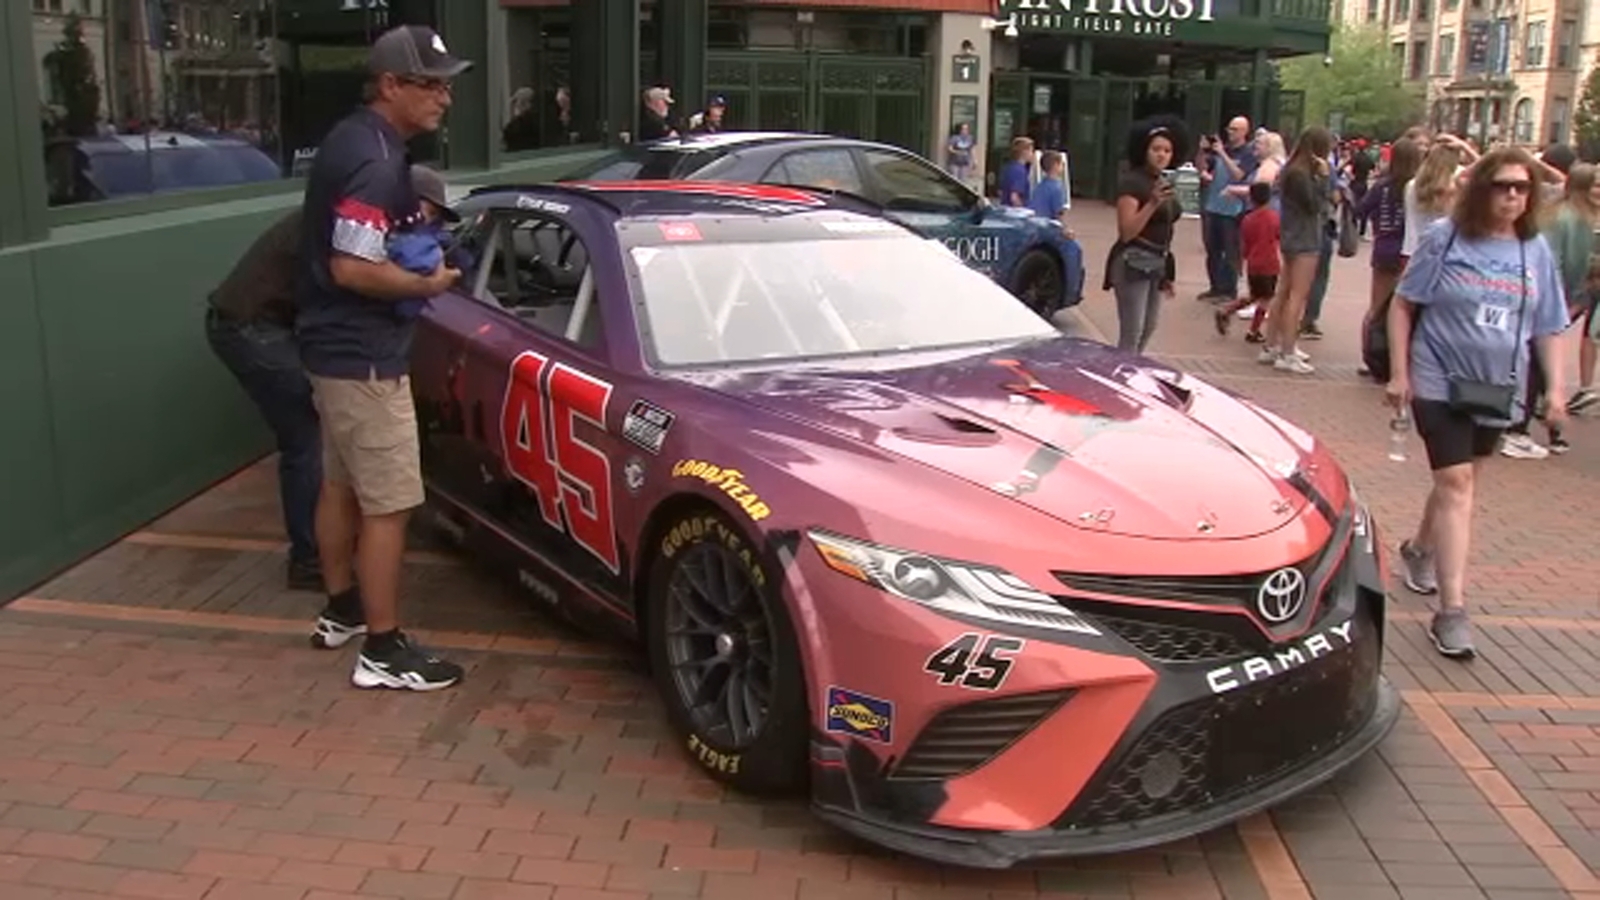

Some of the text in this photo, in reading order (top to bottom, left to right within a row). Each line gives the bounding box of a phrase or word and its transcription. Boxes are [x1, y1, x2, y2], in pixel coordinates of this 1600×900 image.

[1073, 18, 1122, 33] FIELD
[1134, 21, 1172, 36] GATE
[501, 350, 620, 576] 45
[671, 459, 772, 521] GOODYEAR
[662, 517, 766, 587] GOODYEAR
[924, 632, 1024, 692] 45
[1206, 620, 1353, 693] CAMRY
[831, 705, 889, 731] SUNOCO
[688, 733, 741, 774] EAGLE
